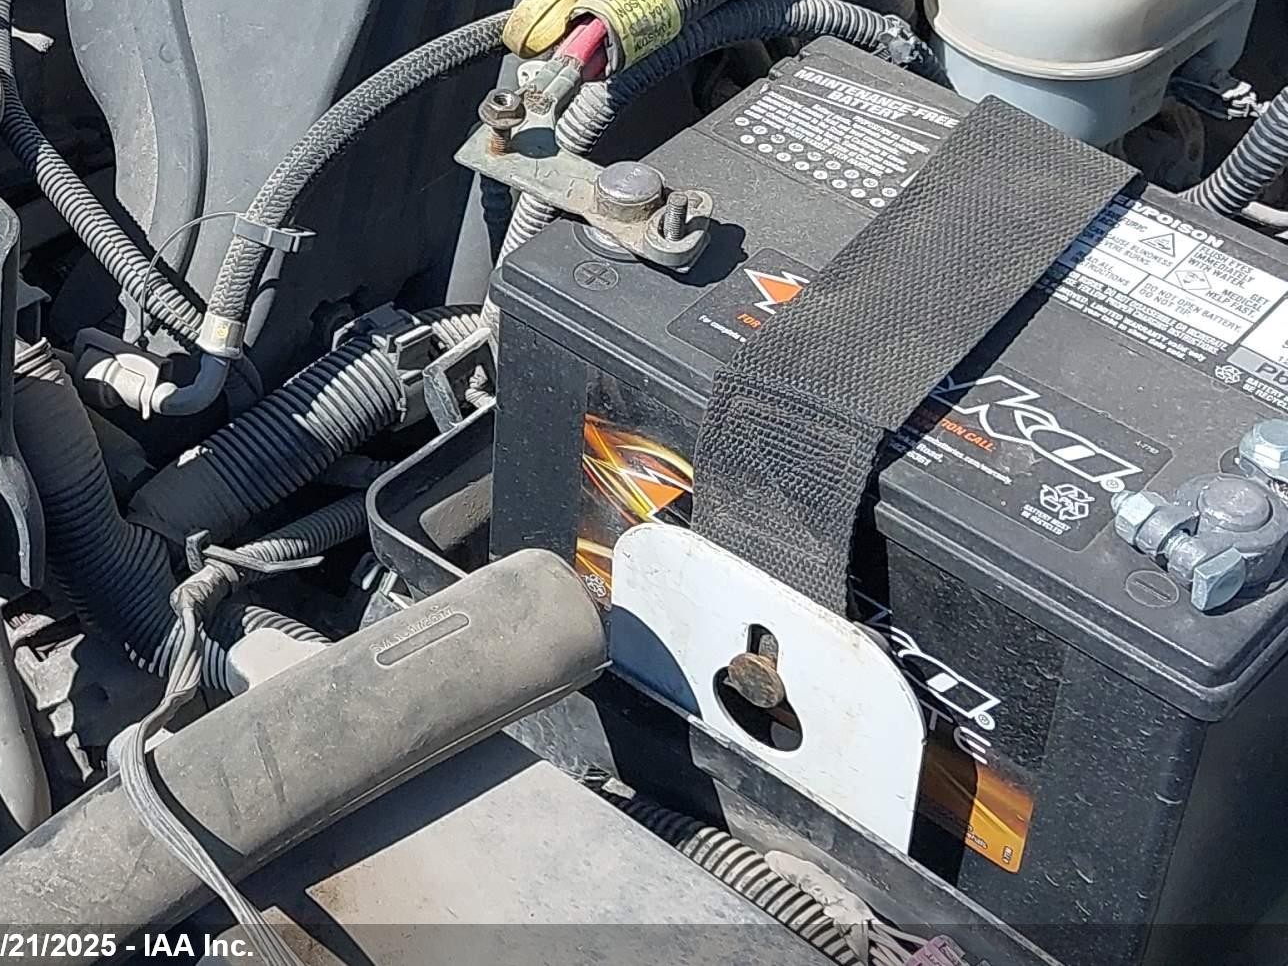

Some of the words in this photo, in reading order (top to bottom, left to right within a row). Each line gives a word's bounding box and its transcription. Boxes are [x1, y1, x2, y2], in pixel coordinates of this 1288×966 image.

[794, 69, 960, 128] MAINTENANCE-FREE
[827, 90, 907, 120] BATTERY
[1188, 258, 1213, 273] WITH
[1194, 251, 1254, 285] IMMEDIATELY
[1200, 246, 1230, 264] FLUSH
[1229, 260, 1253, 275] EYES
[1139, 288, 1153, 298] DO
[1152, 295, 1174, 309] NOT
[1144, 283, 1159, 293] DO
[1158, 289, 1178, 302] NOT
[1177, 298, 1202, 314] OPEN
[1206, 290, 1231, 306] HELP
[1230, 302, 1256, 318] FAST.
[1222, 289, 1263, 313] MEDICAL
[1250, 294, 1269, 306] GET
[737, 314, 761, 328] FOR
[1123, 317, 1168, 343] WARRANTY
[1242, 383, 1255, 392] BE
[1254, 389, 1288, 411] RECYCL
[1246, 377, 1285, 399] BATTERY
[916, 443, 945, 462] Road,
